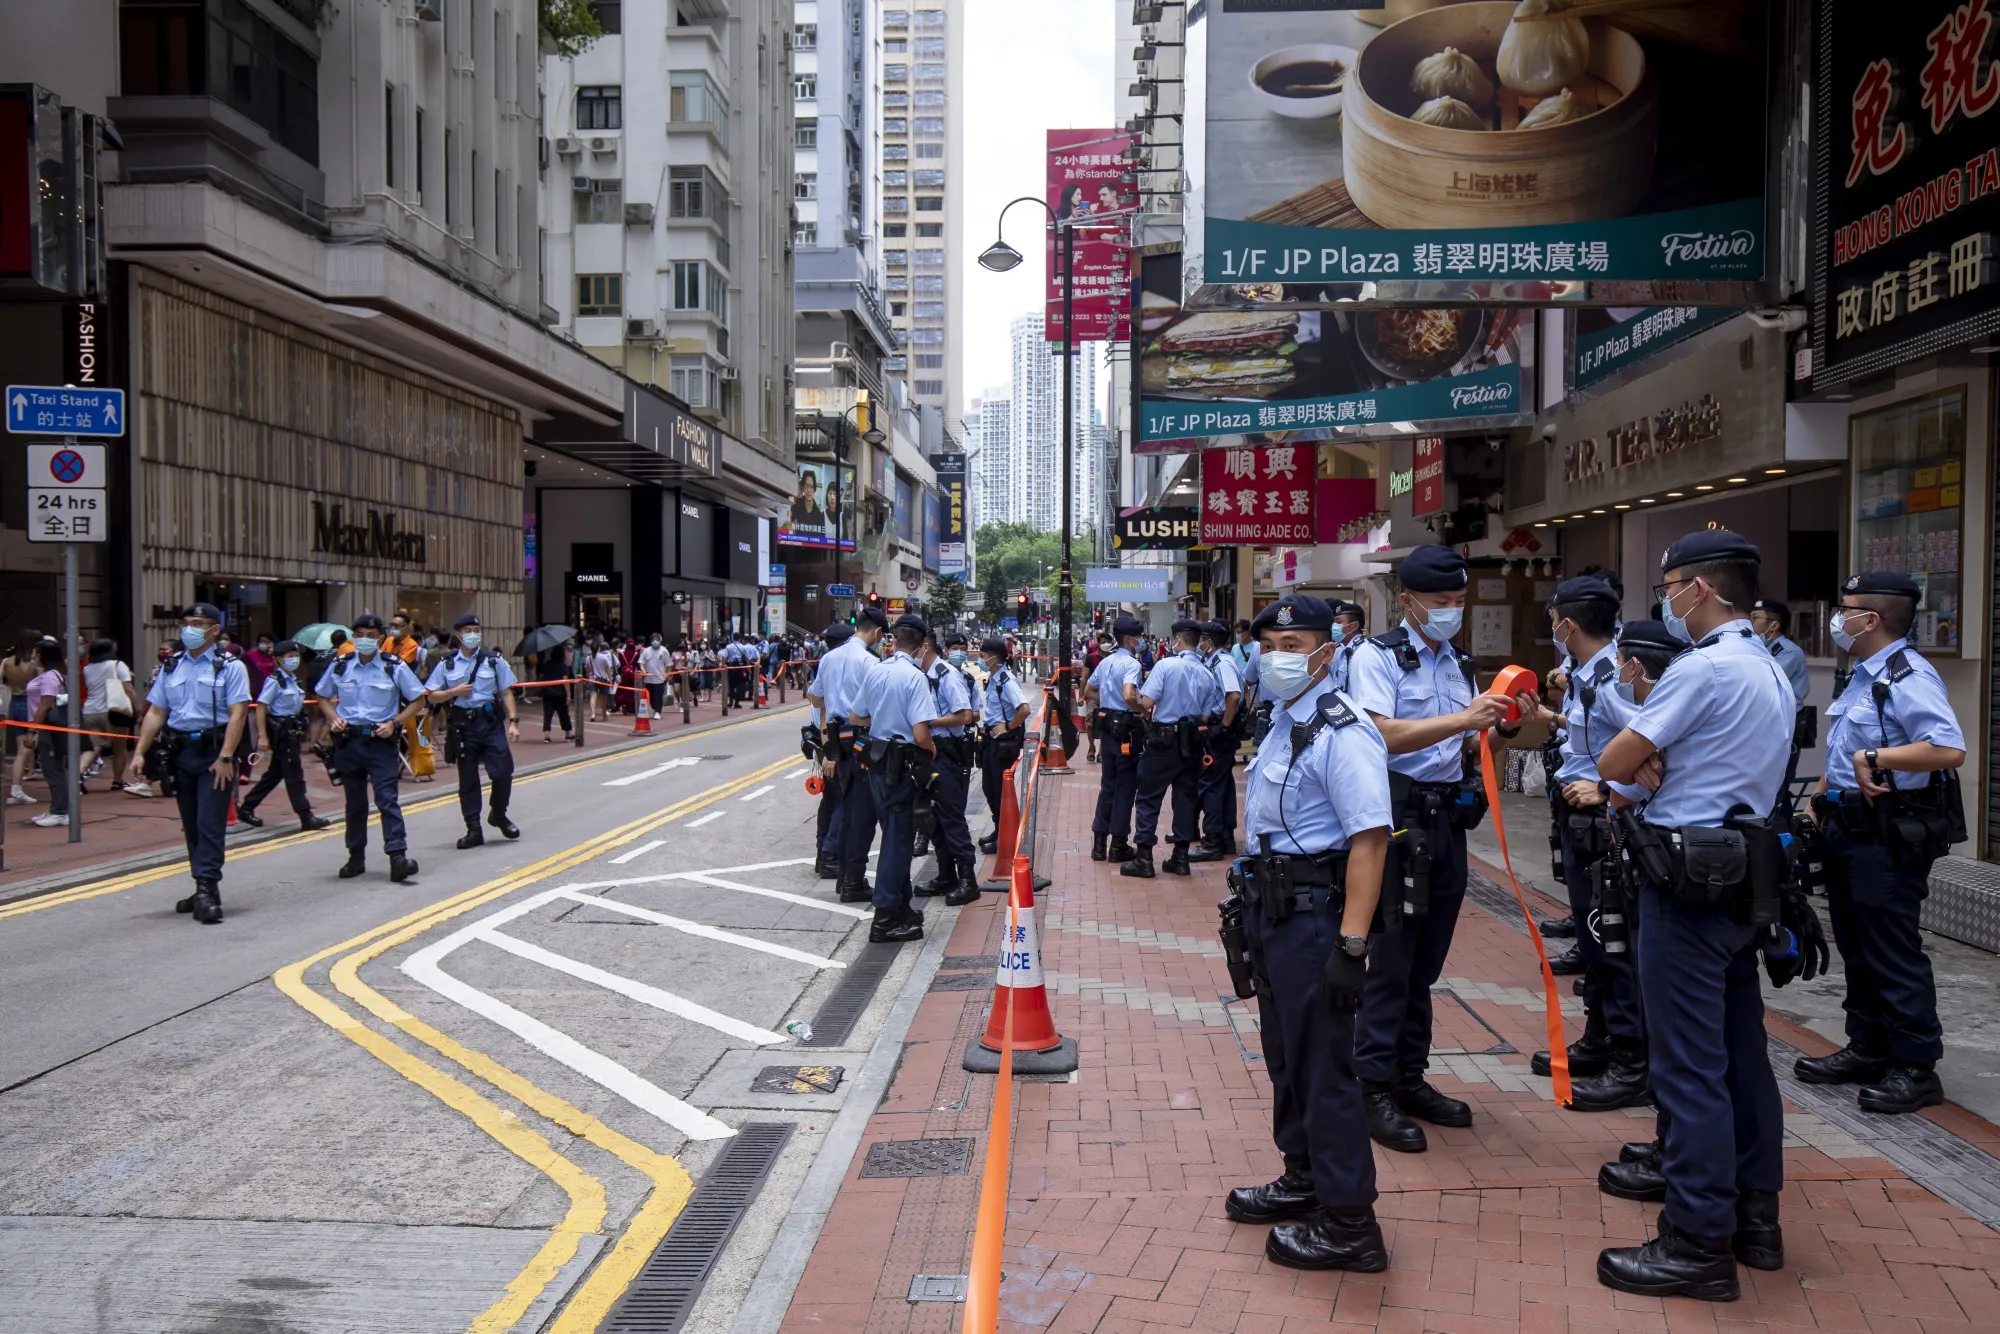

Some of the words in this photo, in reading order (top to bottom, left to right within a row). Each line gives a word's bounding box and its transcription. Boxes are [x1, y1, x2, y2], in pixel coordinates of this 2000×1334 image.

[1834, 204, 1890, 267] HONG
[1895, 168, 1961, 237] KONG
[1221, 248, 1267, 277] 1/F
[1274, 249, 1312, 275] JP
[1321, 246, 1400, 274] Plaza
[1412, 240, 1610, 275] 翡翠明珠廣場
[1660, 229, 1755, 267] Festiva
[1835, 231, 1985, 340] 政府註冊
[79, 303, 95, 382] FASHION
[1579, 350, 1593, 375] 1/F
[1593, 345, 1604, 368] JP
[1606, 336, 1629, 361] Plaza
[30, 393, 57, 406] Taxi
[60, 394, 99, 407] Stand
[1449, 382, 1513, 410] Festiva
[37, 411, 92, 428] 的士站
[677, 415, 707, 448] FASHION
[1149, 416, 1176, 434] 1/F
[1179, 414, 1200, 431] JP
[1205, 411, 1251, 429] Plaza
[1258, 399, 1377, 427] 翡翠明珠廣場
[690, 443, 709, 470] WALK
[1607, 416, 1656, 469] TEA
[1224, 447, 1298, 480] 順興
[37, 495, 62, 509] 24
[68, 496, 97, 510] hrs
[682, 503, 700, 518] CHANEL
[950, 482, 962, 536] IKEA
[1208, 489, 1310, 516] 珠寶玉器
[44, 515, 91, 536] 全日
[1126, 520, 1189, 537] LUSH
[1204, 524, 1233, 538] SHUN
[1235, 524, 1261, 538] HING
[1264, 524, 1291, 538] JADE
[1293, 524, 1312, 538] CO.
[577, 574, 609, 582] CHANEL
